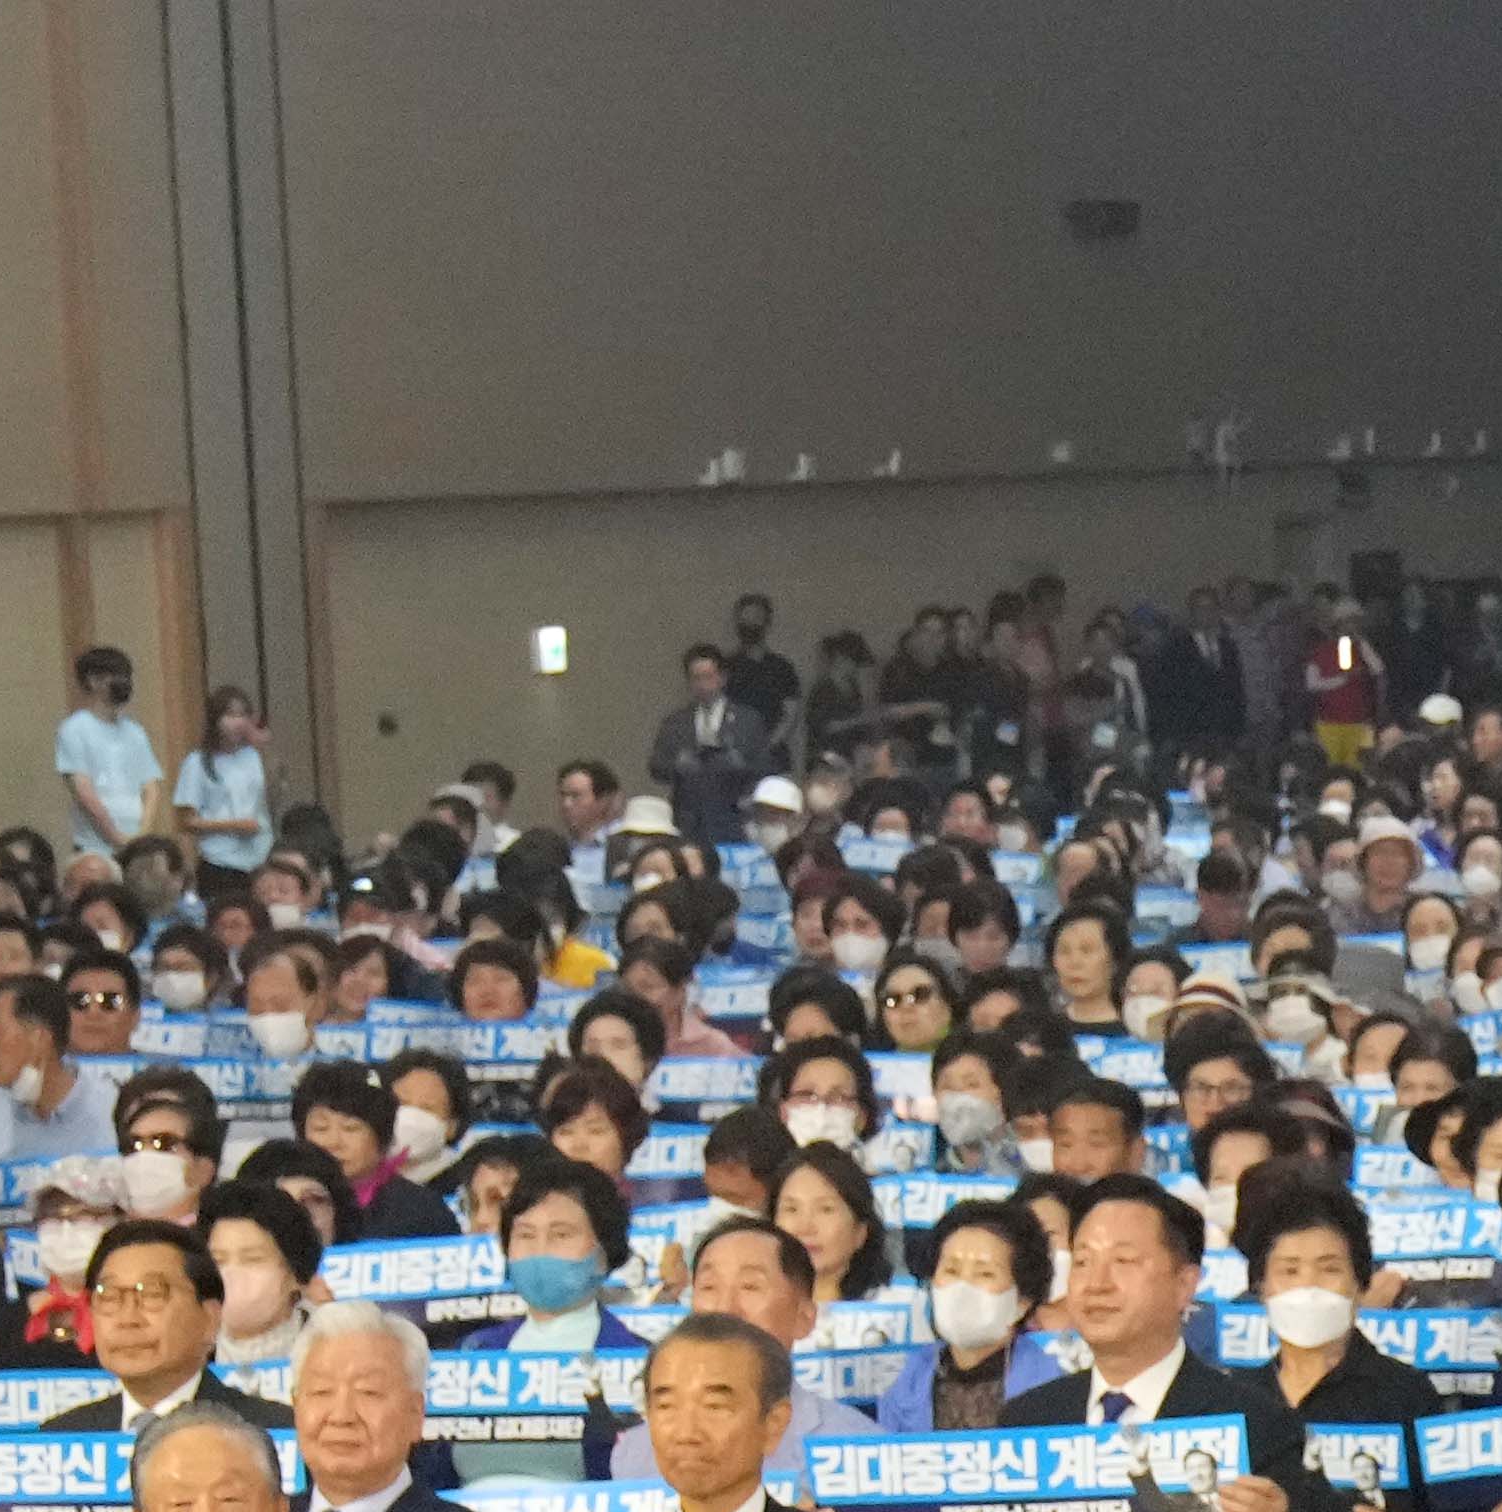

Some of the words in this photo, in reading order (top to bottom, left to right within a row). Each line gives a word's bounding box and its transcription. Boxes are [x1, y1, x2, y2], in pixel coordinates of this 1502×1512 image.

[323, 1244, 504, 1295] 김대중정신
[813, 1435, 1038, 1497] 김대중정신
[1049, 1424, 1240, 1490] 계승발전
